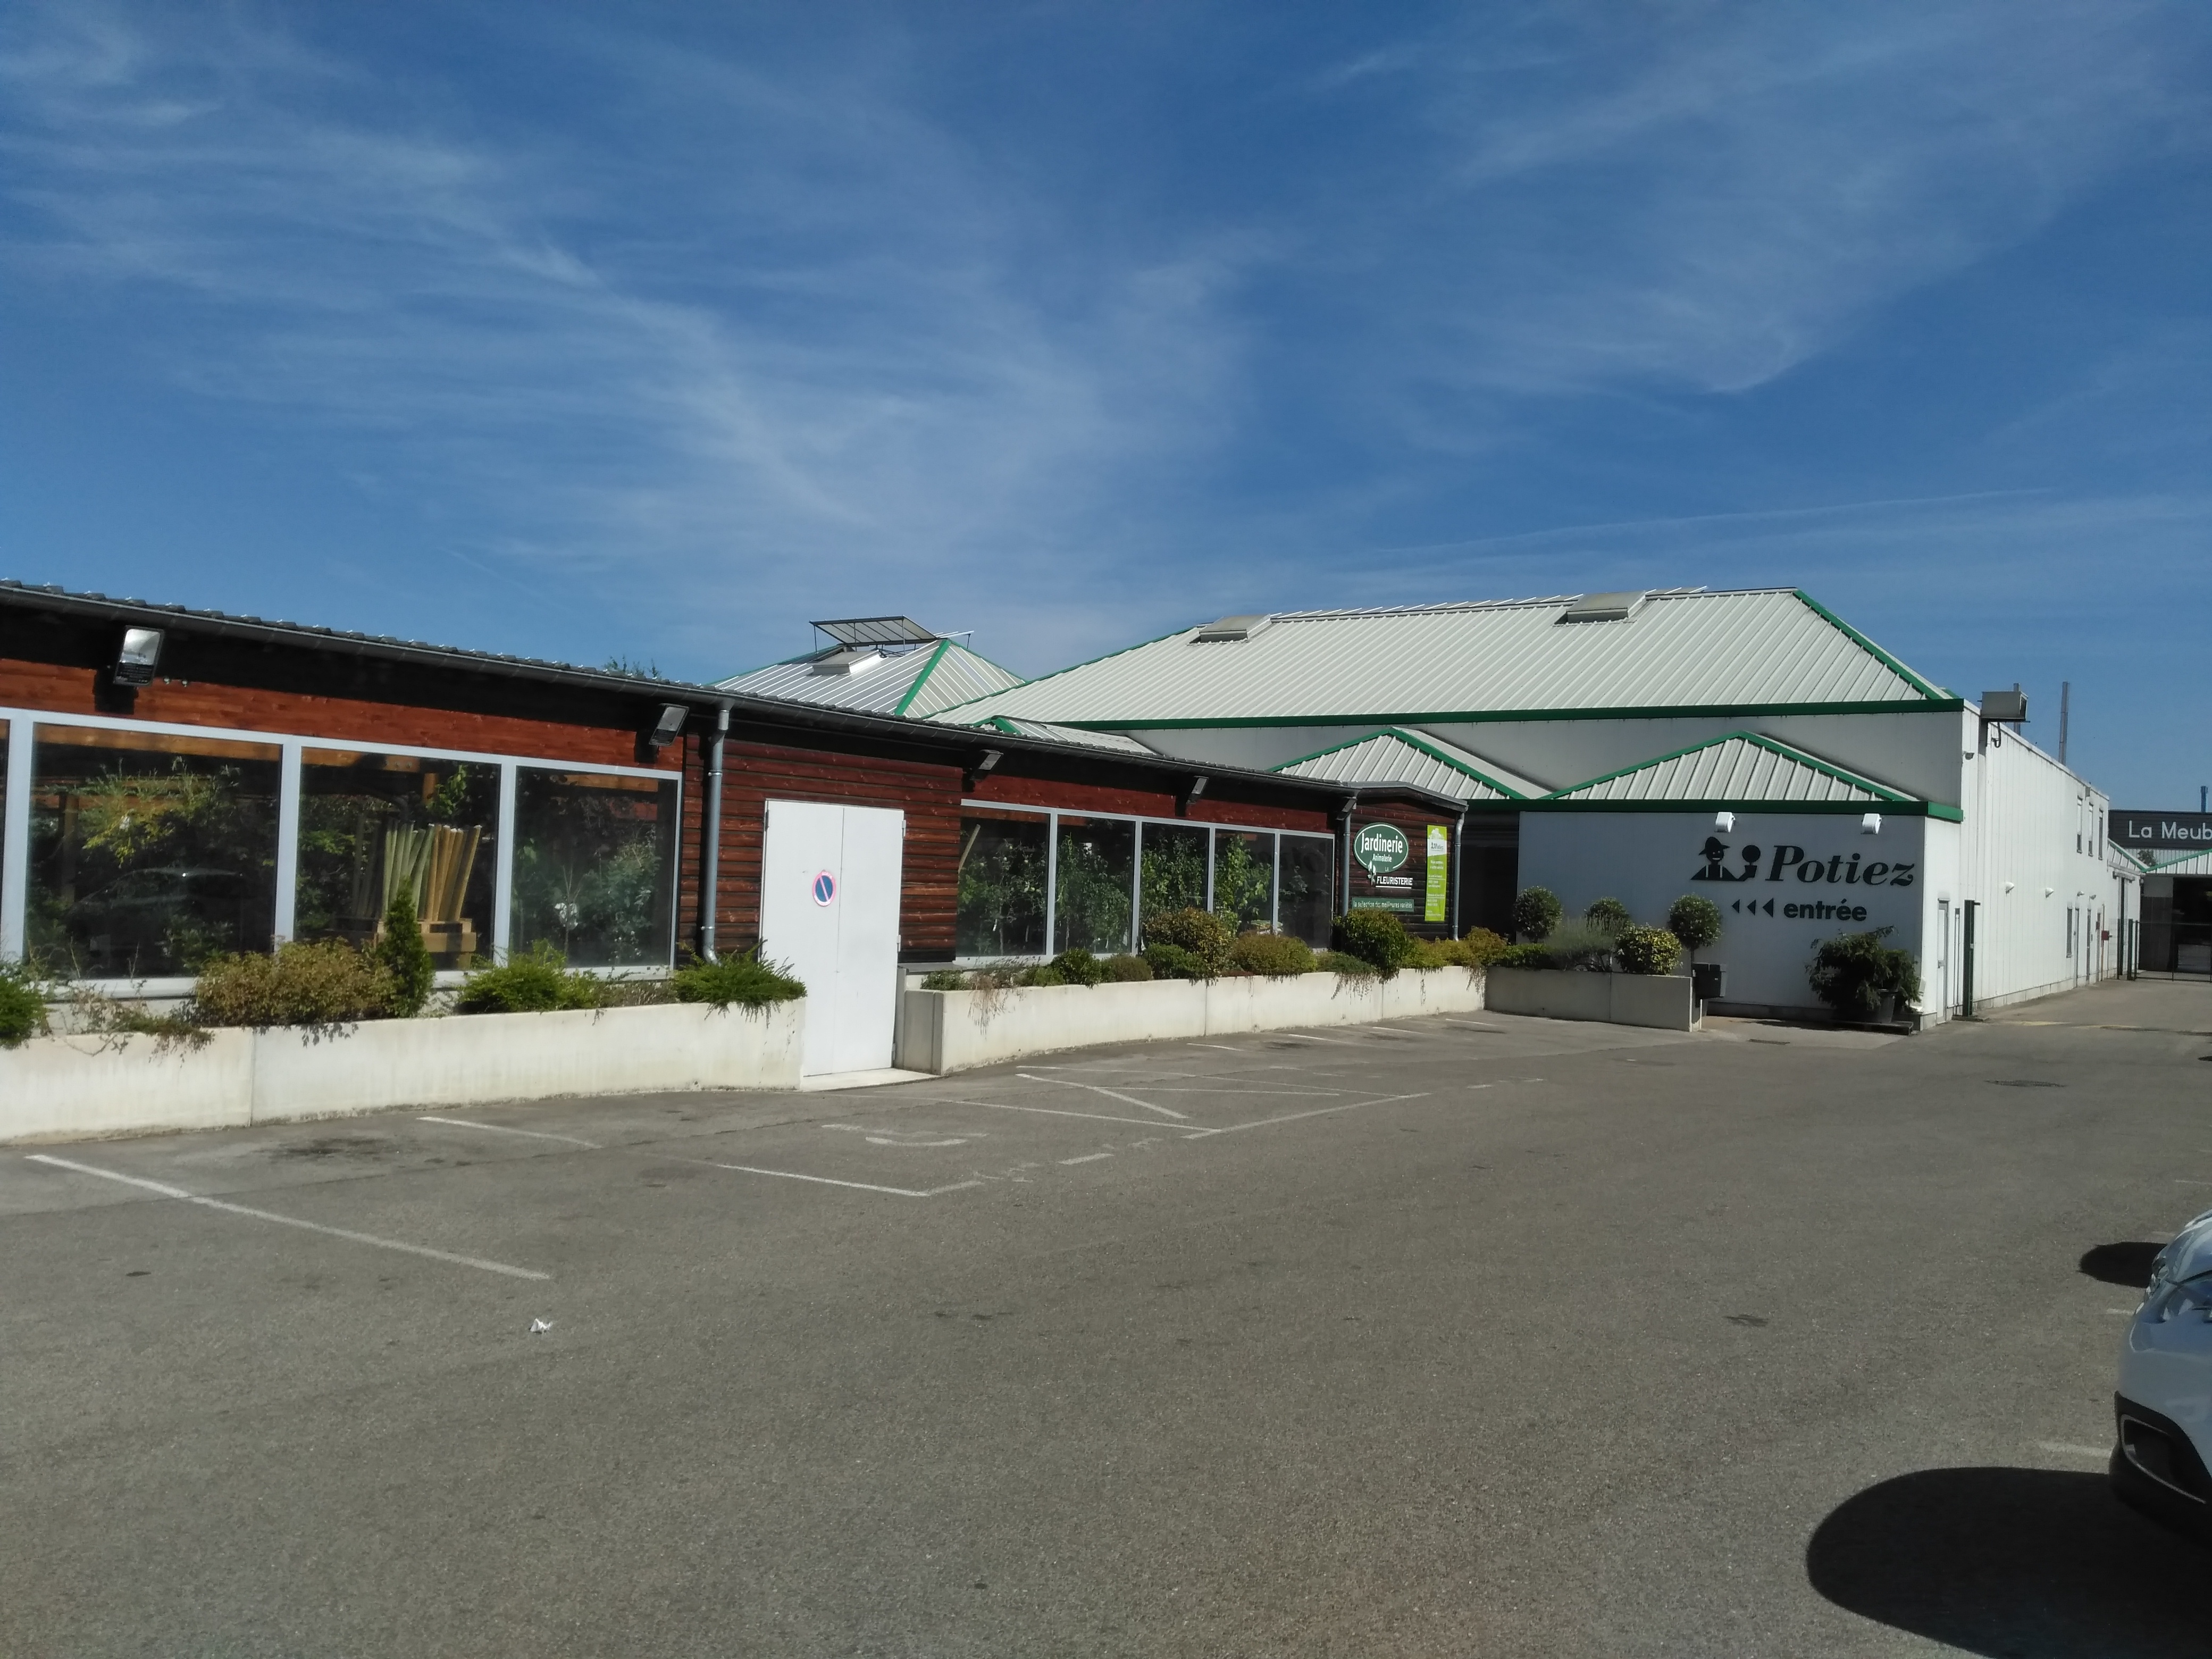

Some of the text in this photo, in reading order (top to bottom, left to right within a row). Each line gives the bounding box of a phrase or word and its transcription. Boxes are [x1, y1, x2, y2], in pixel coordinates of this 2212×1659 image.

[2129, 820, 2152, 838] La
[1361, 833, 1403, 853] Jardinerie
[1372, 853, 1392, 862] Animalerie
[1765, 845, 1915, 886] Potiez
[1377, 876, 1413, 885] FLEURISTERIE
[1783, 899, 1867, 921] entrée
